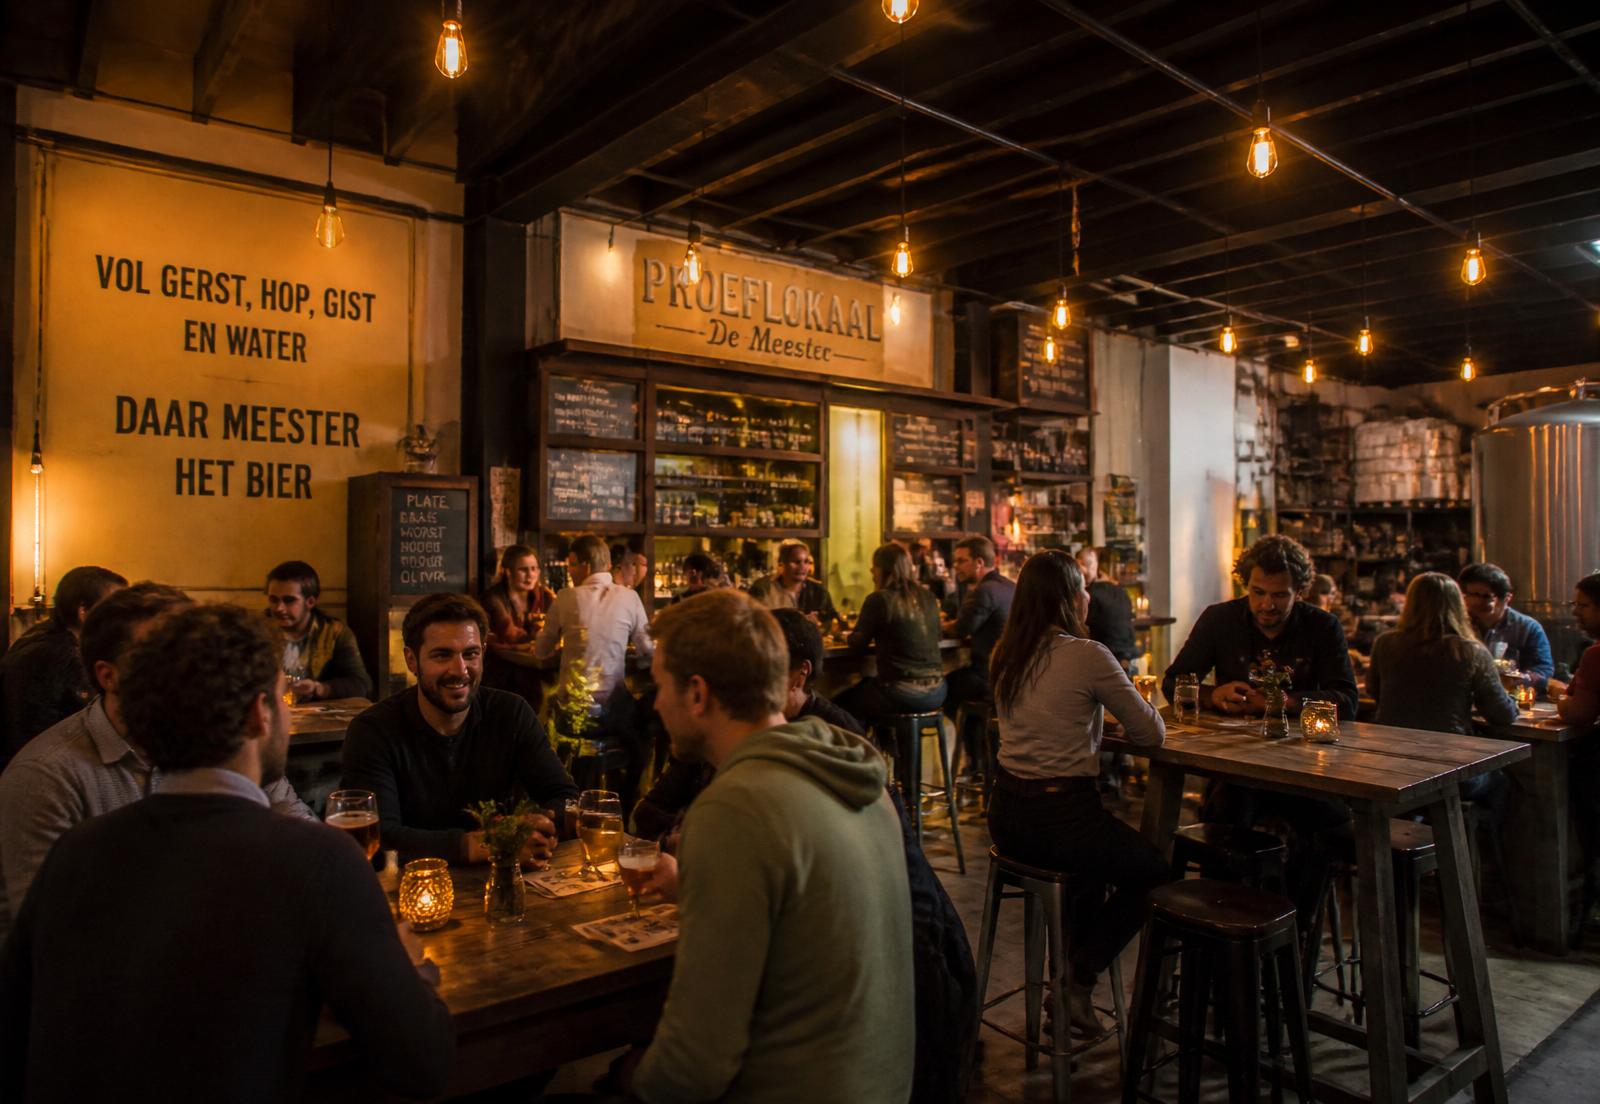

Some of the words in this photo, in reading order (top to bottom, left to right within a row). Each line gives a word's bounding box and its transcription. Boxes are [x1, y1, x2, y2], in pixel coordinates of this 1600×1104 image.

[95, 254, 150, 294] VOL
[161, 264, 252, 312] GERST,
[261, 278, 315, 320] HOP,
[323, 287, 376, 323] GIST
[642, 257, 882, 343] PROEFLOKAAL
[184, 319, 216, 354] EN
[225, 324, 307, 363] WATER
[706, 318, 740, 347] De
[115, 395, 209, 439] DAAR
[222, 403, 360, 448] MEESTER
[175, 457, 235, 496] HET
[246, 461, 313, 500] BIER
[407, 494, 450, 509] PLATE
